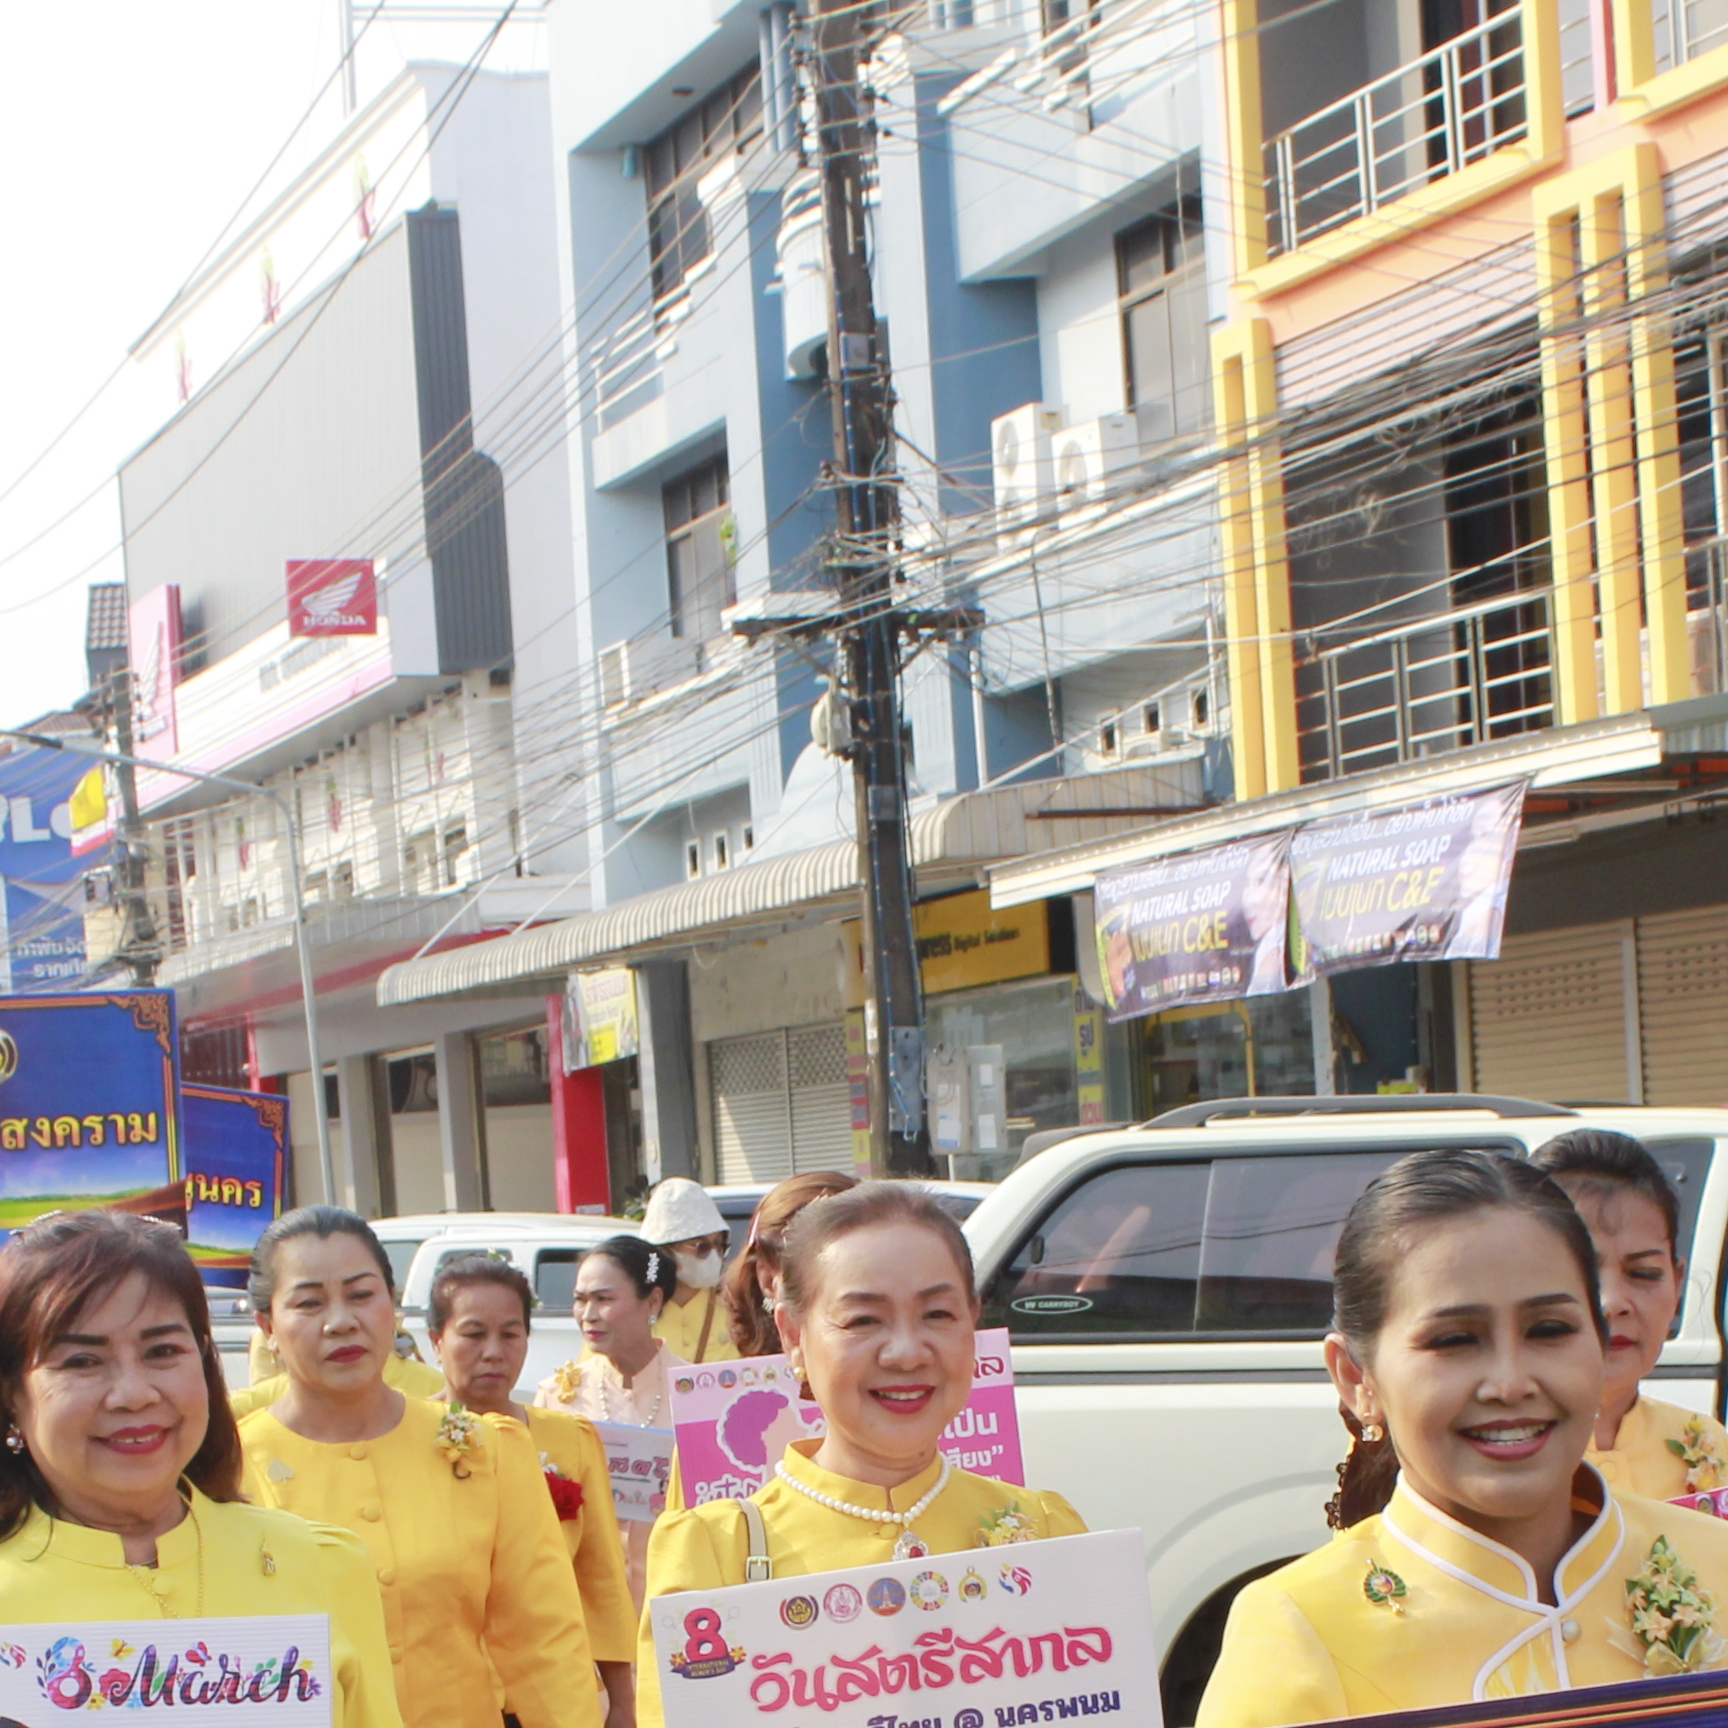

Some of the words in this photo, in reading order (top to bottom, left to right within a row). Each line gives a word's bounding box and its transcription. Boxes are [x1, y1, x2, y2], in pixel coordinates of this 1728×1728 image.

[303, 614, 367, 626] HONDA
[1327, 845, 1399, 882] NATURAL
[1400, 834, 1452, 869] SOAP
[1131, 887, 1189, 926] NATURAL
[1190, 880, 1232, 912] SOAP
[1387, 866, 1446, 912] C&E
[1183, 909, 1230, 955] C&E
[683, 1607, 729, 1663] 8
[45, 1637, 93, 1710] 8
[108, 1644, 314, 1708] March
[749, 1625, 1113, 1713] วันสตรีสากล
